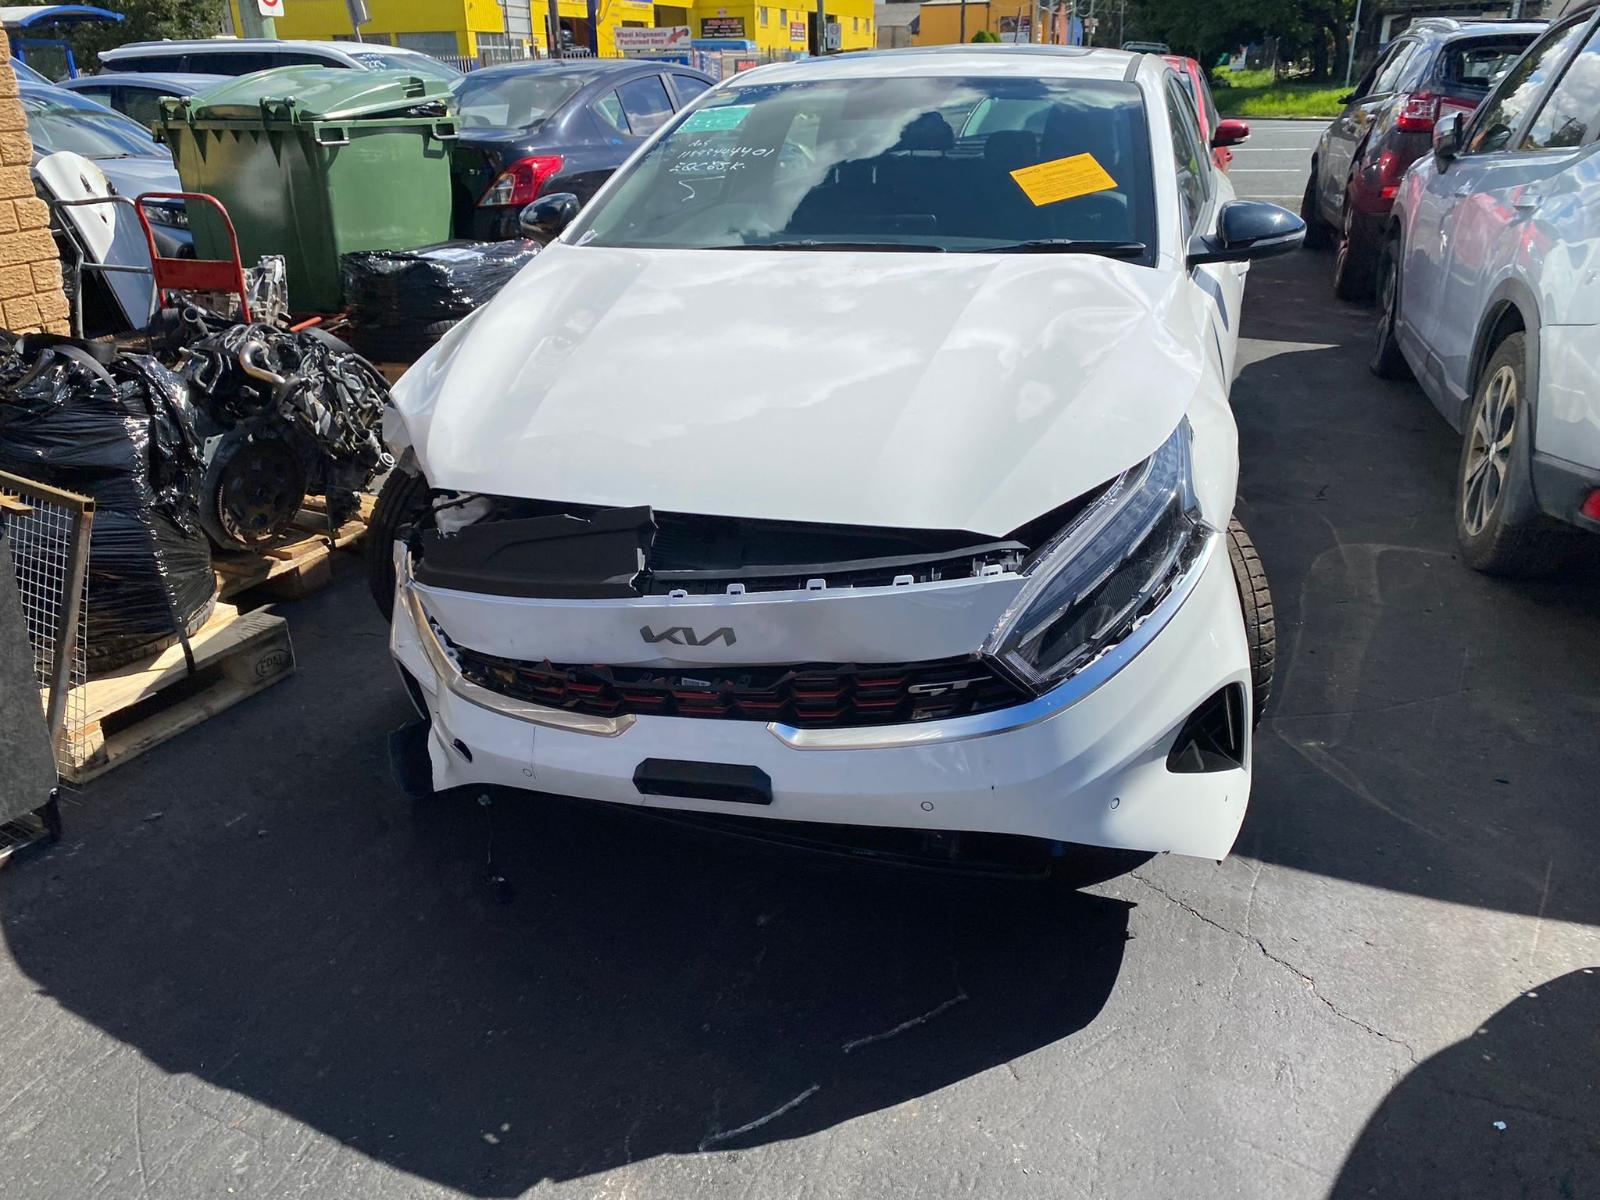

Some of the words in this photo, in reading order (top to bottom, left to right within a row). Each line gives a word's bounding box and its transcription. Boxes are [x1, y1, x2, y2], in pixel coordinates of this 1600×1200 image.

[635, 31, 667, 39] Alignments
[640, 625, 737, 647] KIA
[908, 676, 993, 696] GT
